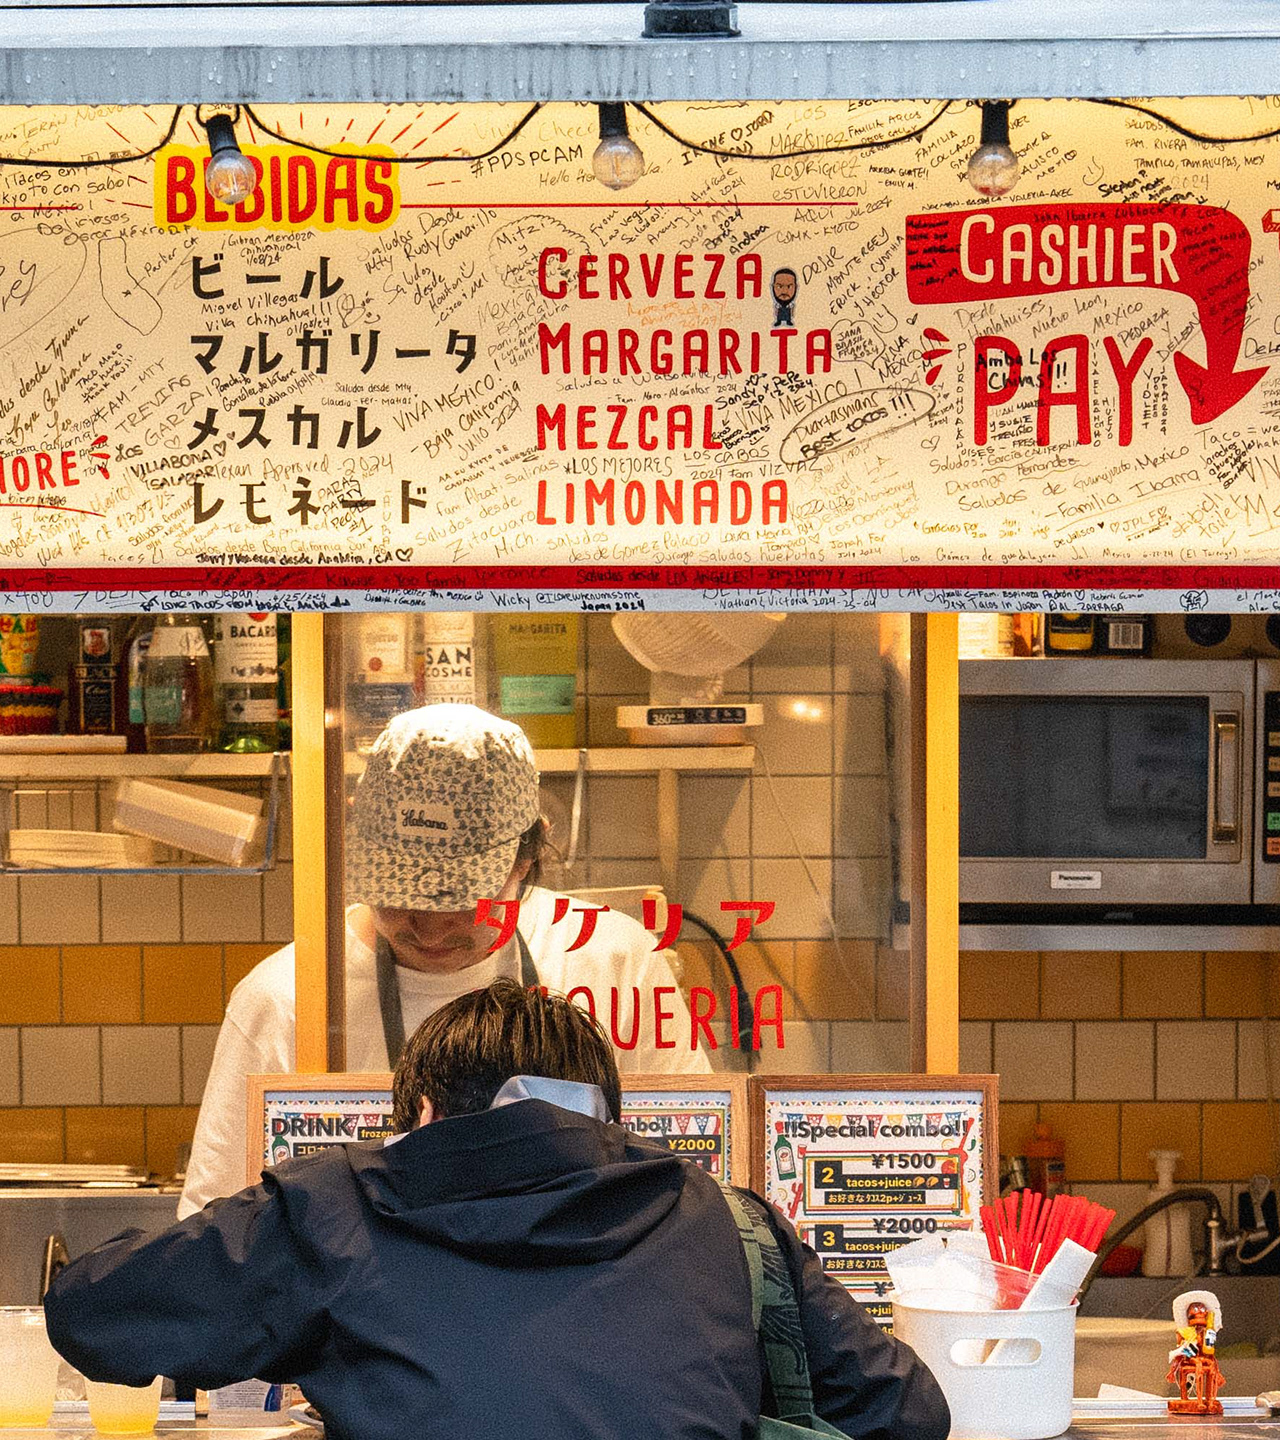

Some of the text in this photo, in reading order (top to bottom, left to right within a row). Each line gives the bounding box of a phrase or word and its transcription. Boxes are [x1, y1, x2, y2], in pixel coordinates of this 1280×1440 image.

[960, 213, 1180, 285] CASHIER
[192, 254, 345, 300] ビール
[538, 246, 764, 301] CERVEZA
[191, 329, 477, 376] マルガリータ
[539, 322, 832, 376] MARGARITA
[974, 333, 1153, 447] PAY
[187, 404, 382, 451] メスカル
[535, 402, 724, 452] MEZCAL
[193, 476, 427, 526] レモネード
[536, 478, 789, 527] LIMONADA
[425, 647, 472, 666] SAN
[473, 898, 776, 953] タケリア
[271, 1117, 354, 1138] DRINK
[668, 1138, 717, 1151] ¥2000
[821, 1167, 835, 1183] 2
[871, 1153, 936, 1170] ¥1500
[822, 1230, 836, 1247] 3
[845, 1241, 906, 1252] tacos+juic
[873, 1217, 937, 1234] ¥2000
